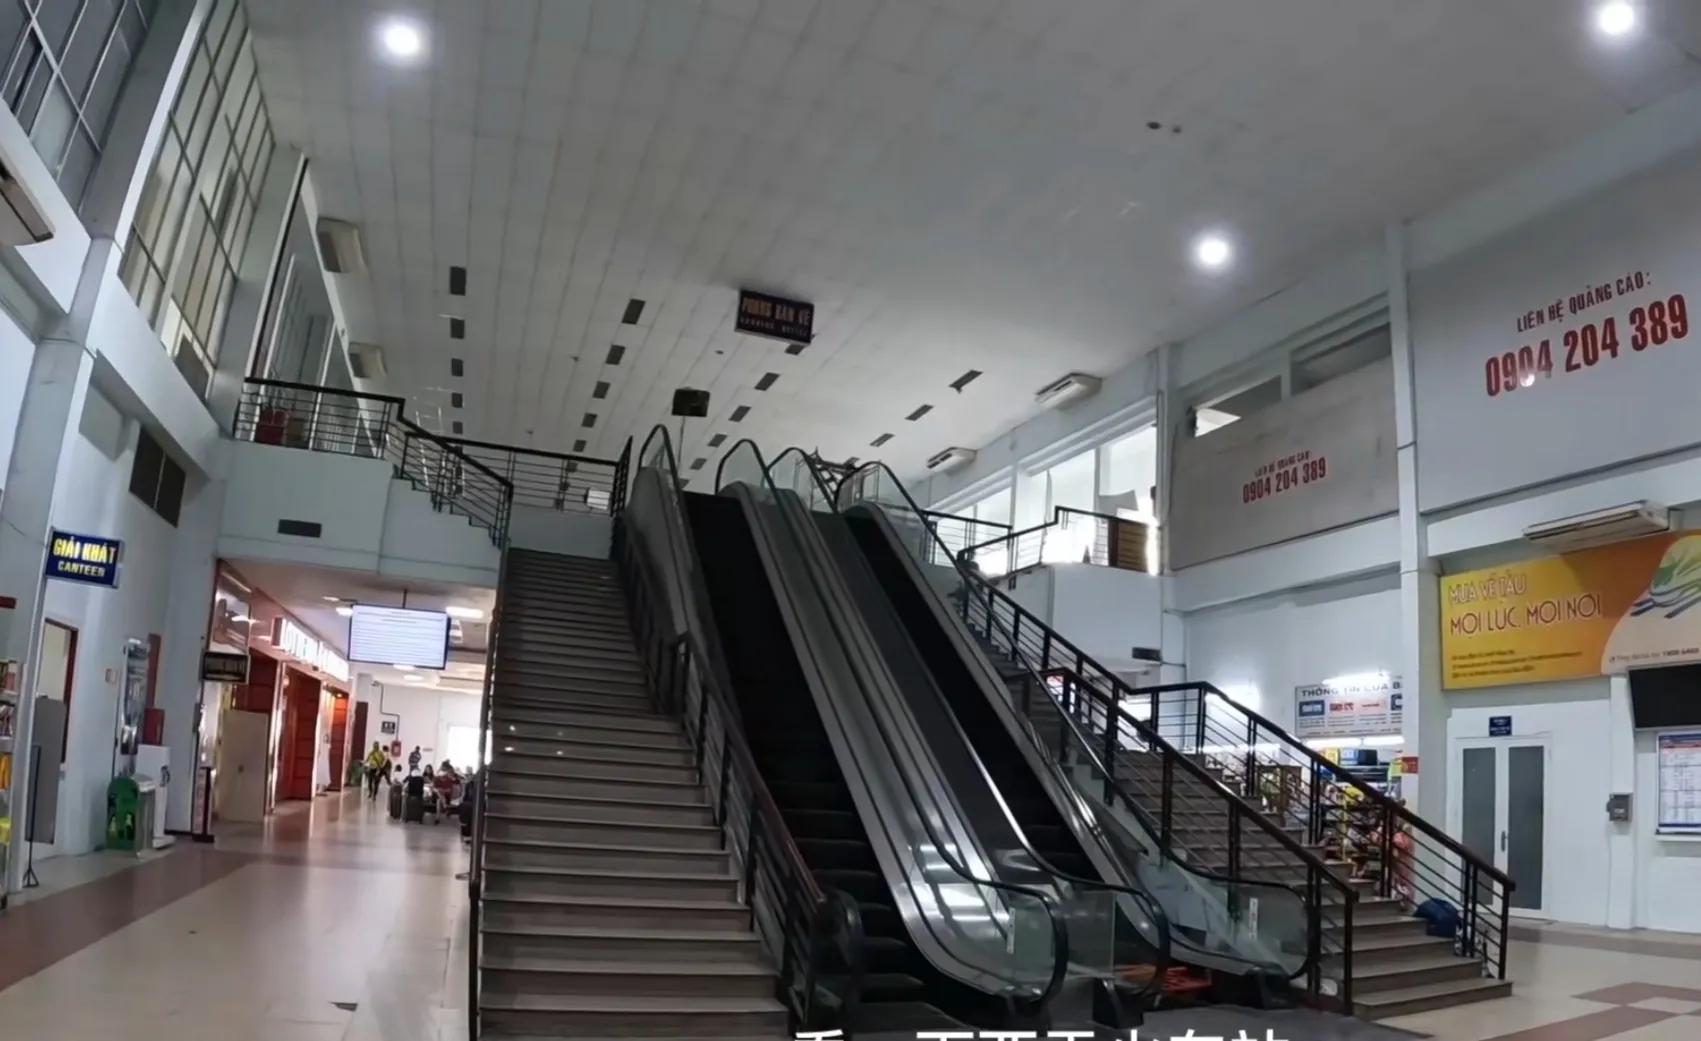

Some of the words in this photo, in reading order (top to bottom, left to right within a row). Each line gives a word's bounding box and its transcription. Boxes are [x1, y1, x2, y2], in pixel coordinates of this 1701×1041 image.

[1485, 338, 1553, 397] 0904
[1563, 316, 1620, 373] 204
[1628, 293, 1689, 351] 389
[1243, 476, 1271, 504] 0904
[1275, 466, 1298, 493] 204
[1302, 456, 1326, 484] 389
[57, 560, 105, 577] CANTEEN
